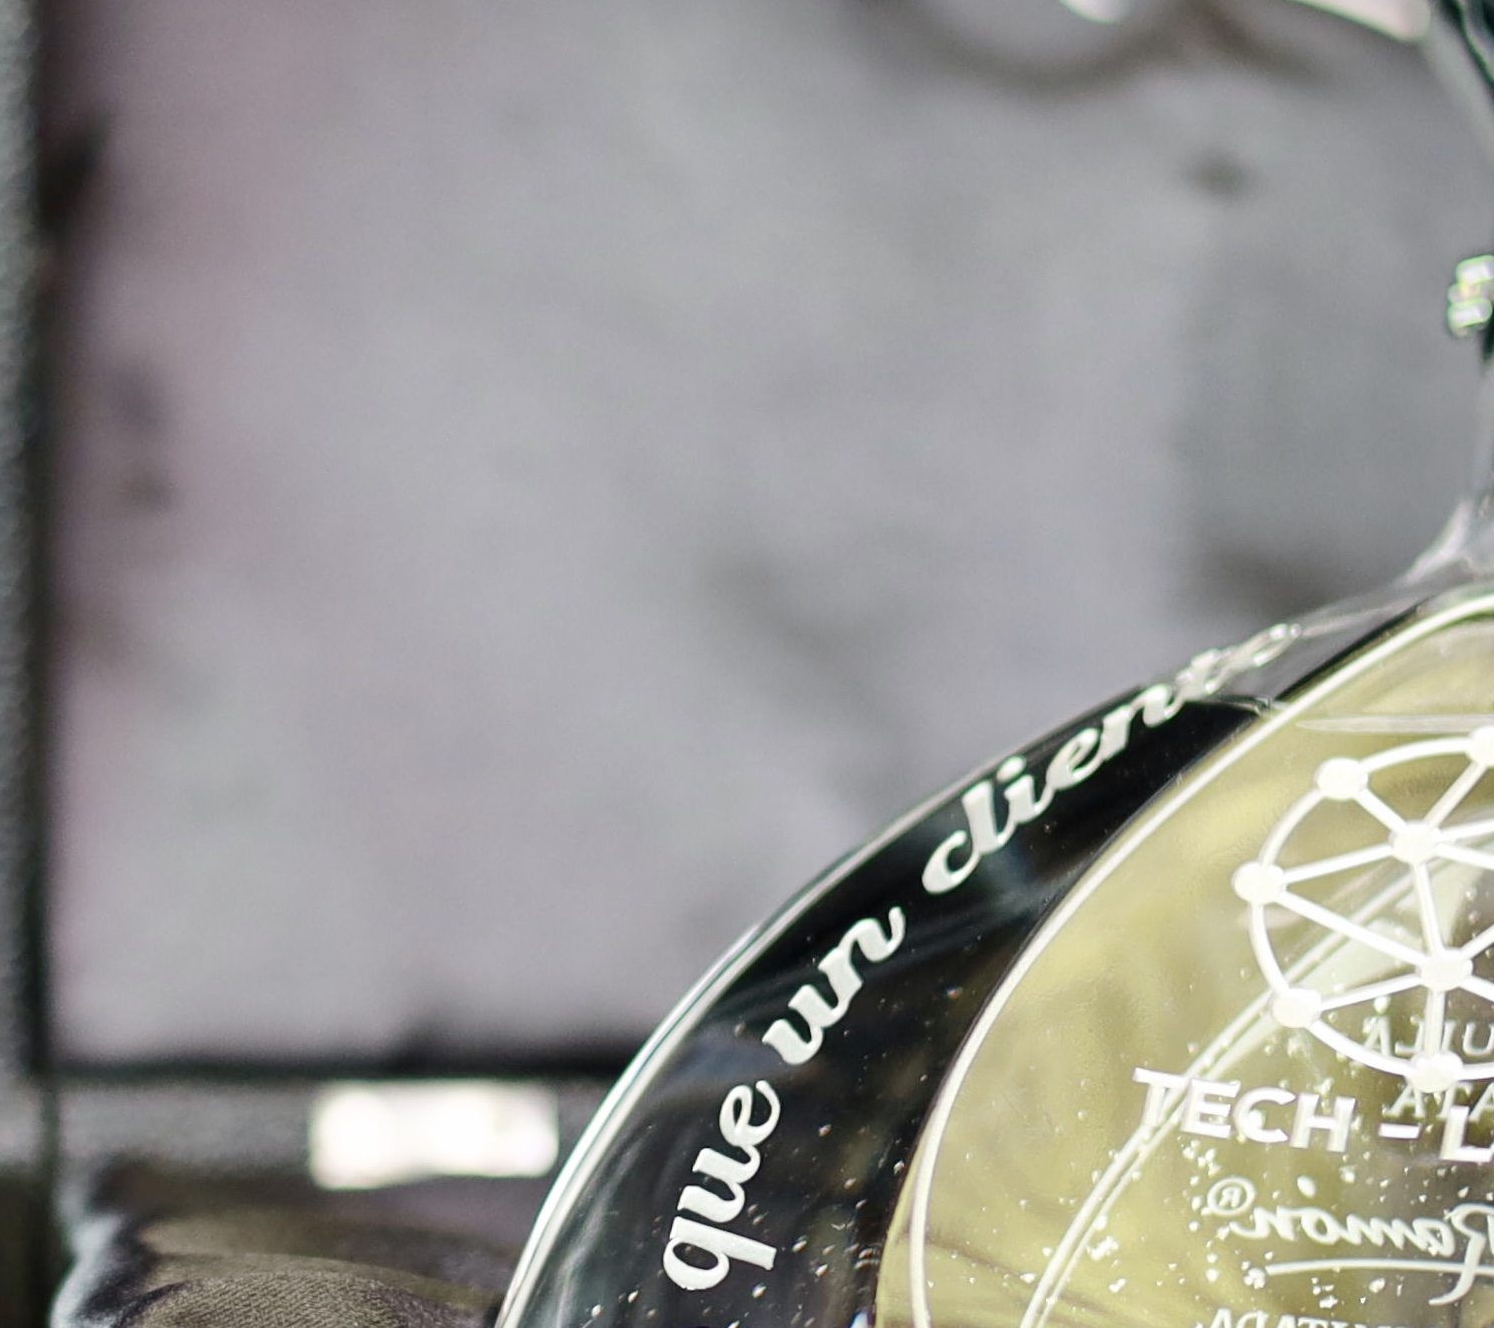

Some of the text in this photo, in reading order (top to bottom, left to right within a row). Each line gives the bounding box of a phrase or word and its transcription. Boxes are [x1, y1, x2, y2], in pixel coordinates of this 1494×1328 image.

[661, 1080, 781, 1291] que
[761, 906, 907, 1066] un
[1133, 1065, 1357, 1155] TECH
